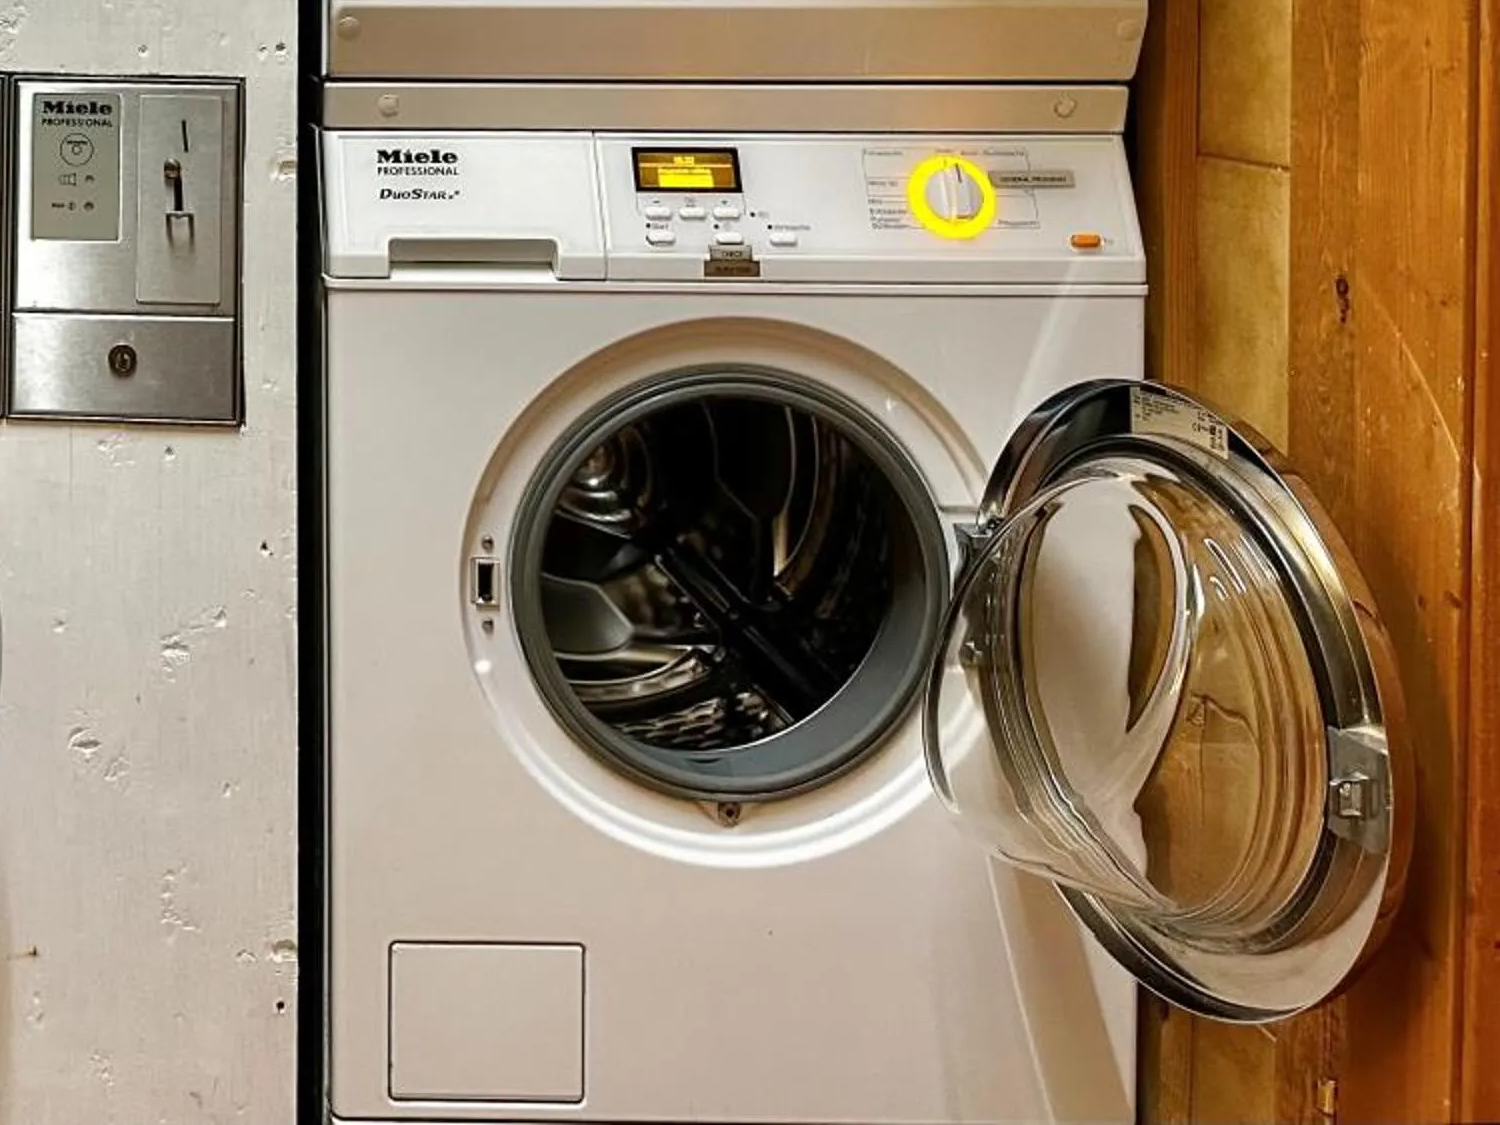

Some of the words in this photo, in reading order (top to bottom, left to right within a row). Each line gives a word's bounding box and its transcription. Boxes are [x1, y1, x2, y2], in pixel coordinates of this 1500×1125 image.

[43, 100, 113, 115] Miele
[41, 118, 113, 127] PROFESSIONAL
[377, 149, 458, 164] Miele
[377, 166, 460, 176] PROFESSIONAL
